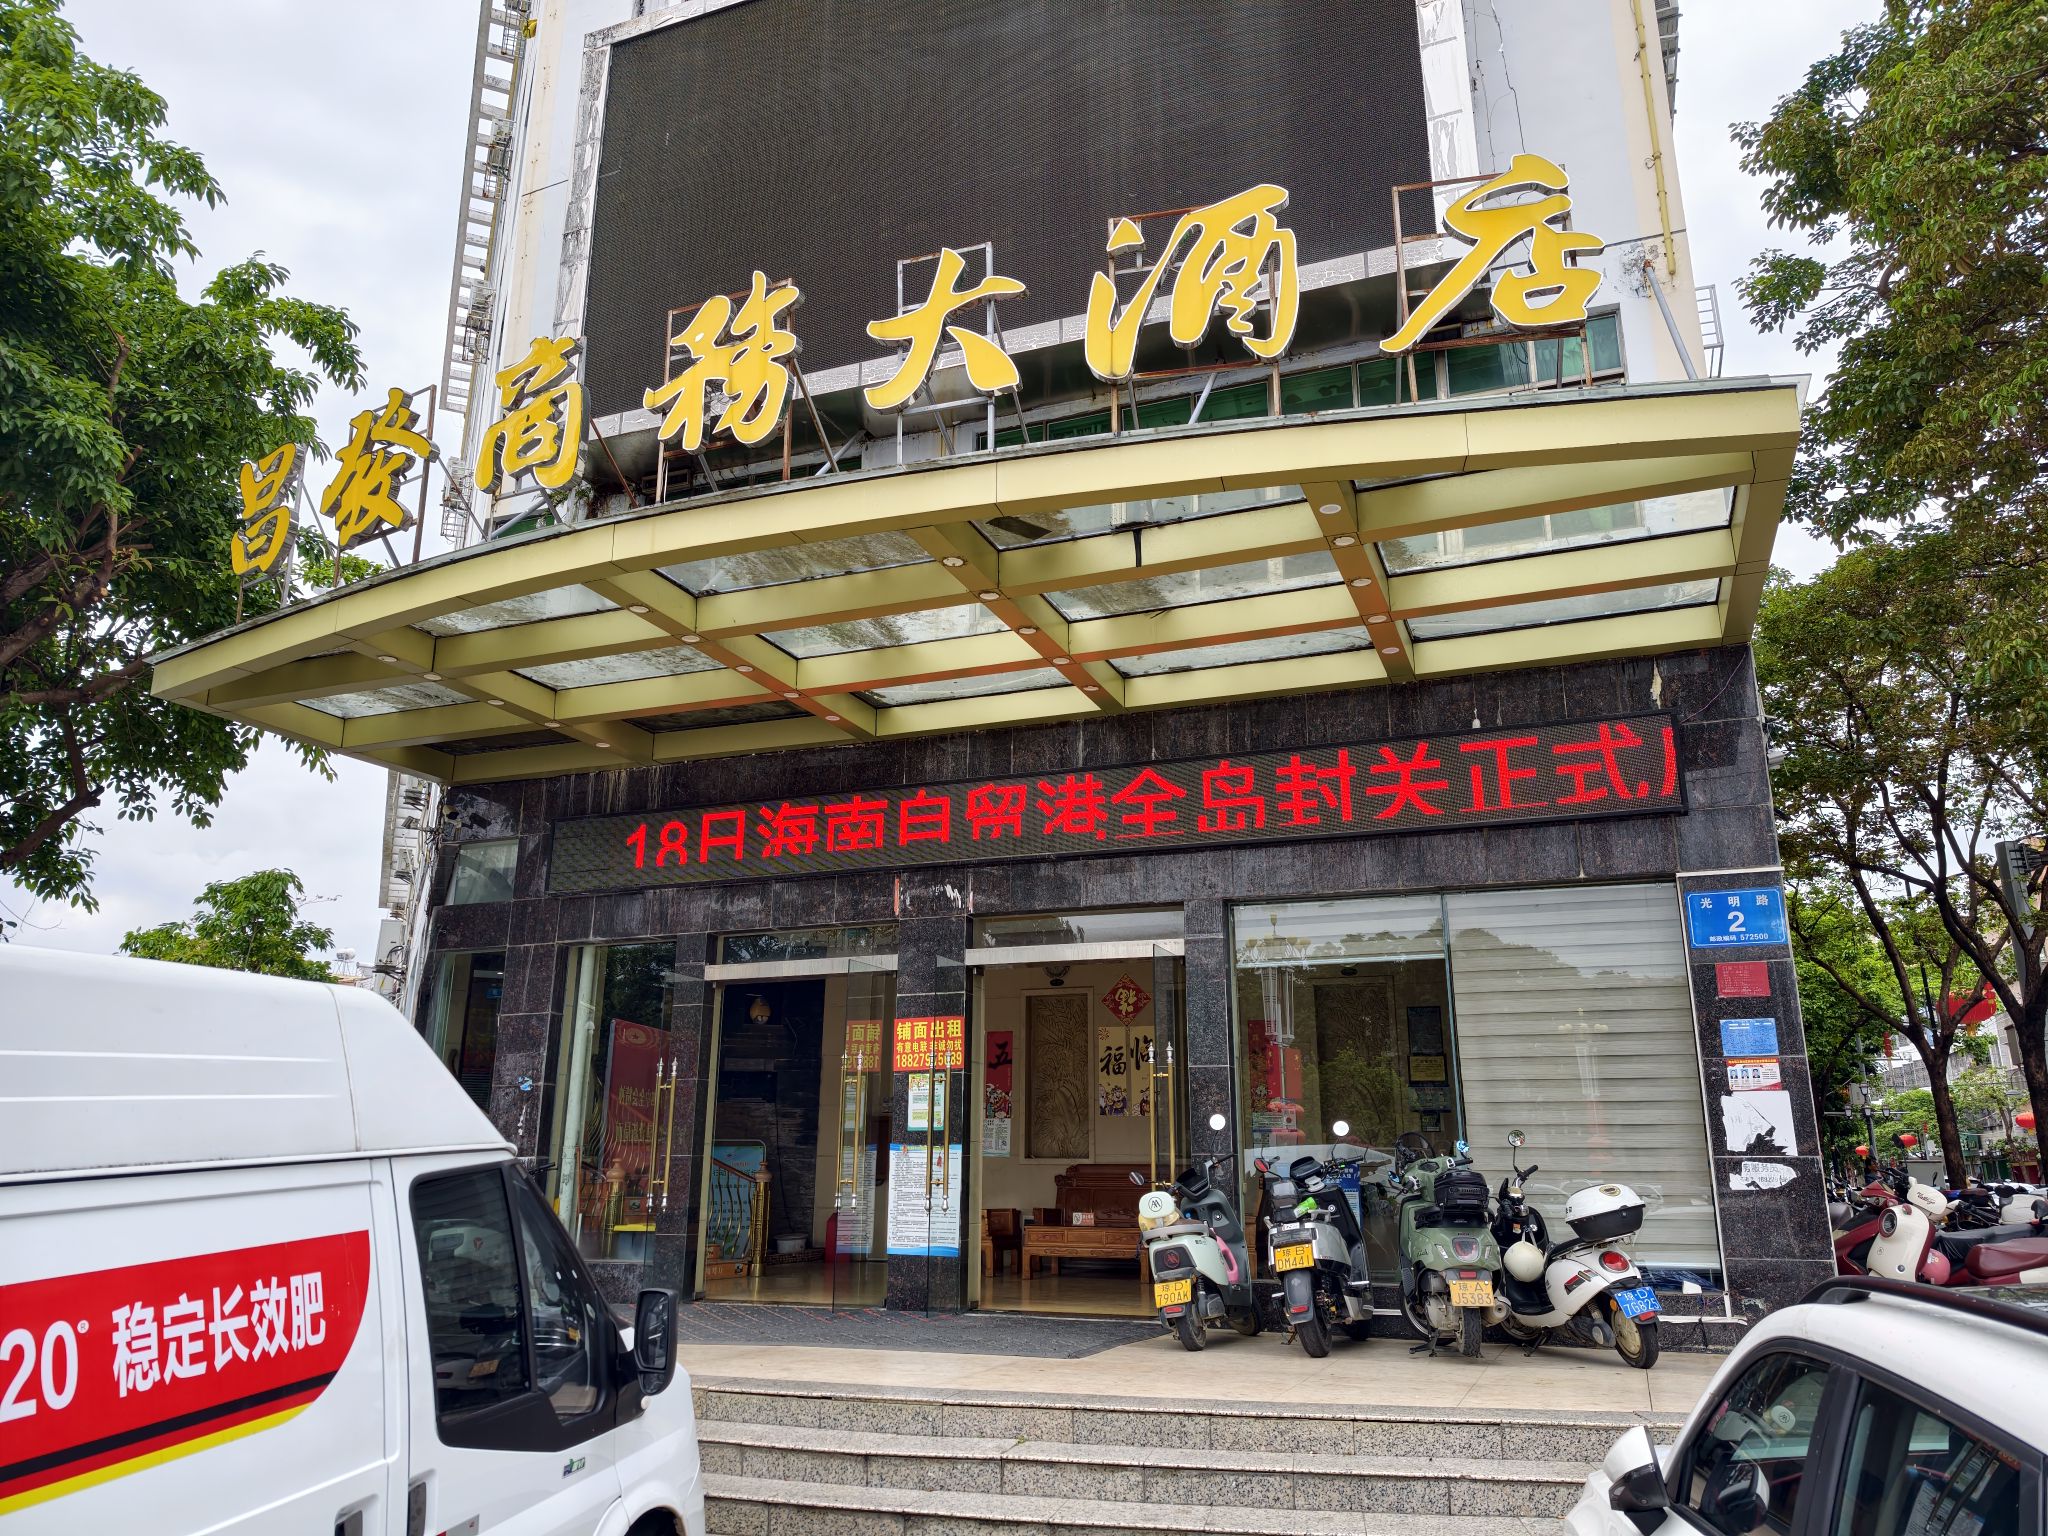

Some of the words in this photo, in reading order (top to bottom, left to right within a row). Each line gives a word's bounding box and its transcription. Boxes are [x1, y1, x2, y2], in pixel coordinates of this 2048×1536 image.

[1700, 894, 1769, 909] 光明路
[1727, 911, 1746, 932] 2
[1740, 933, 1769, 941] 572500
[896, 1019, 962, 1041] 铺面出租
[988, 1041, 1013, 1070] 五
[1100, 1046, 1127, 1076] 福
[112, 1271, 326, 1398] 稳定长效肥
